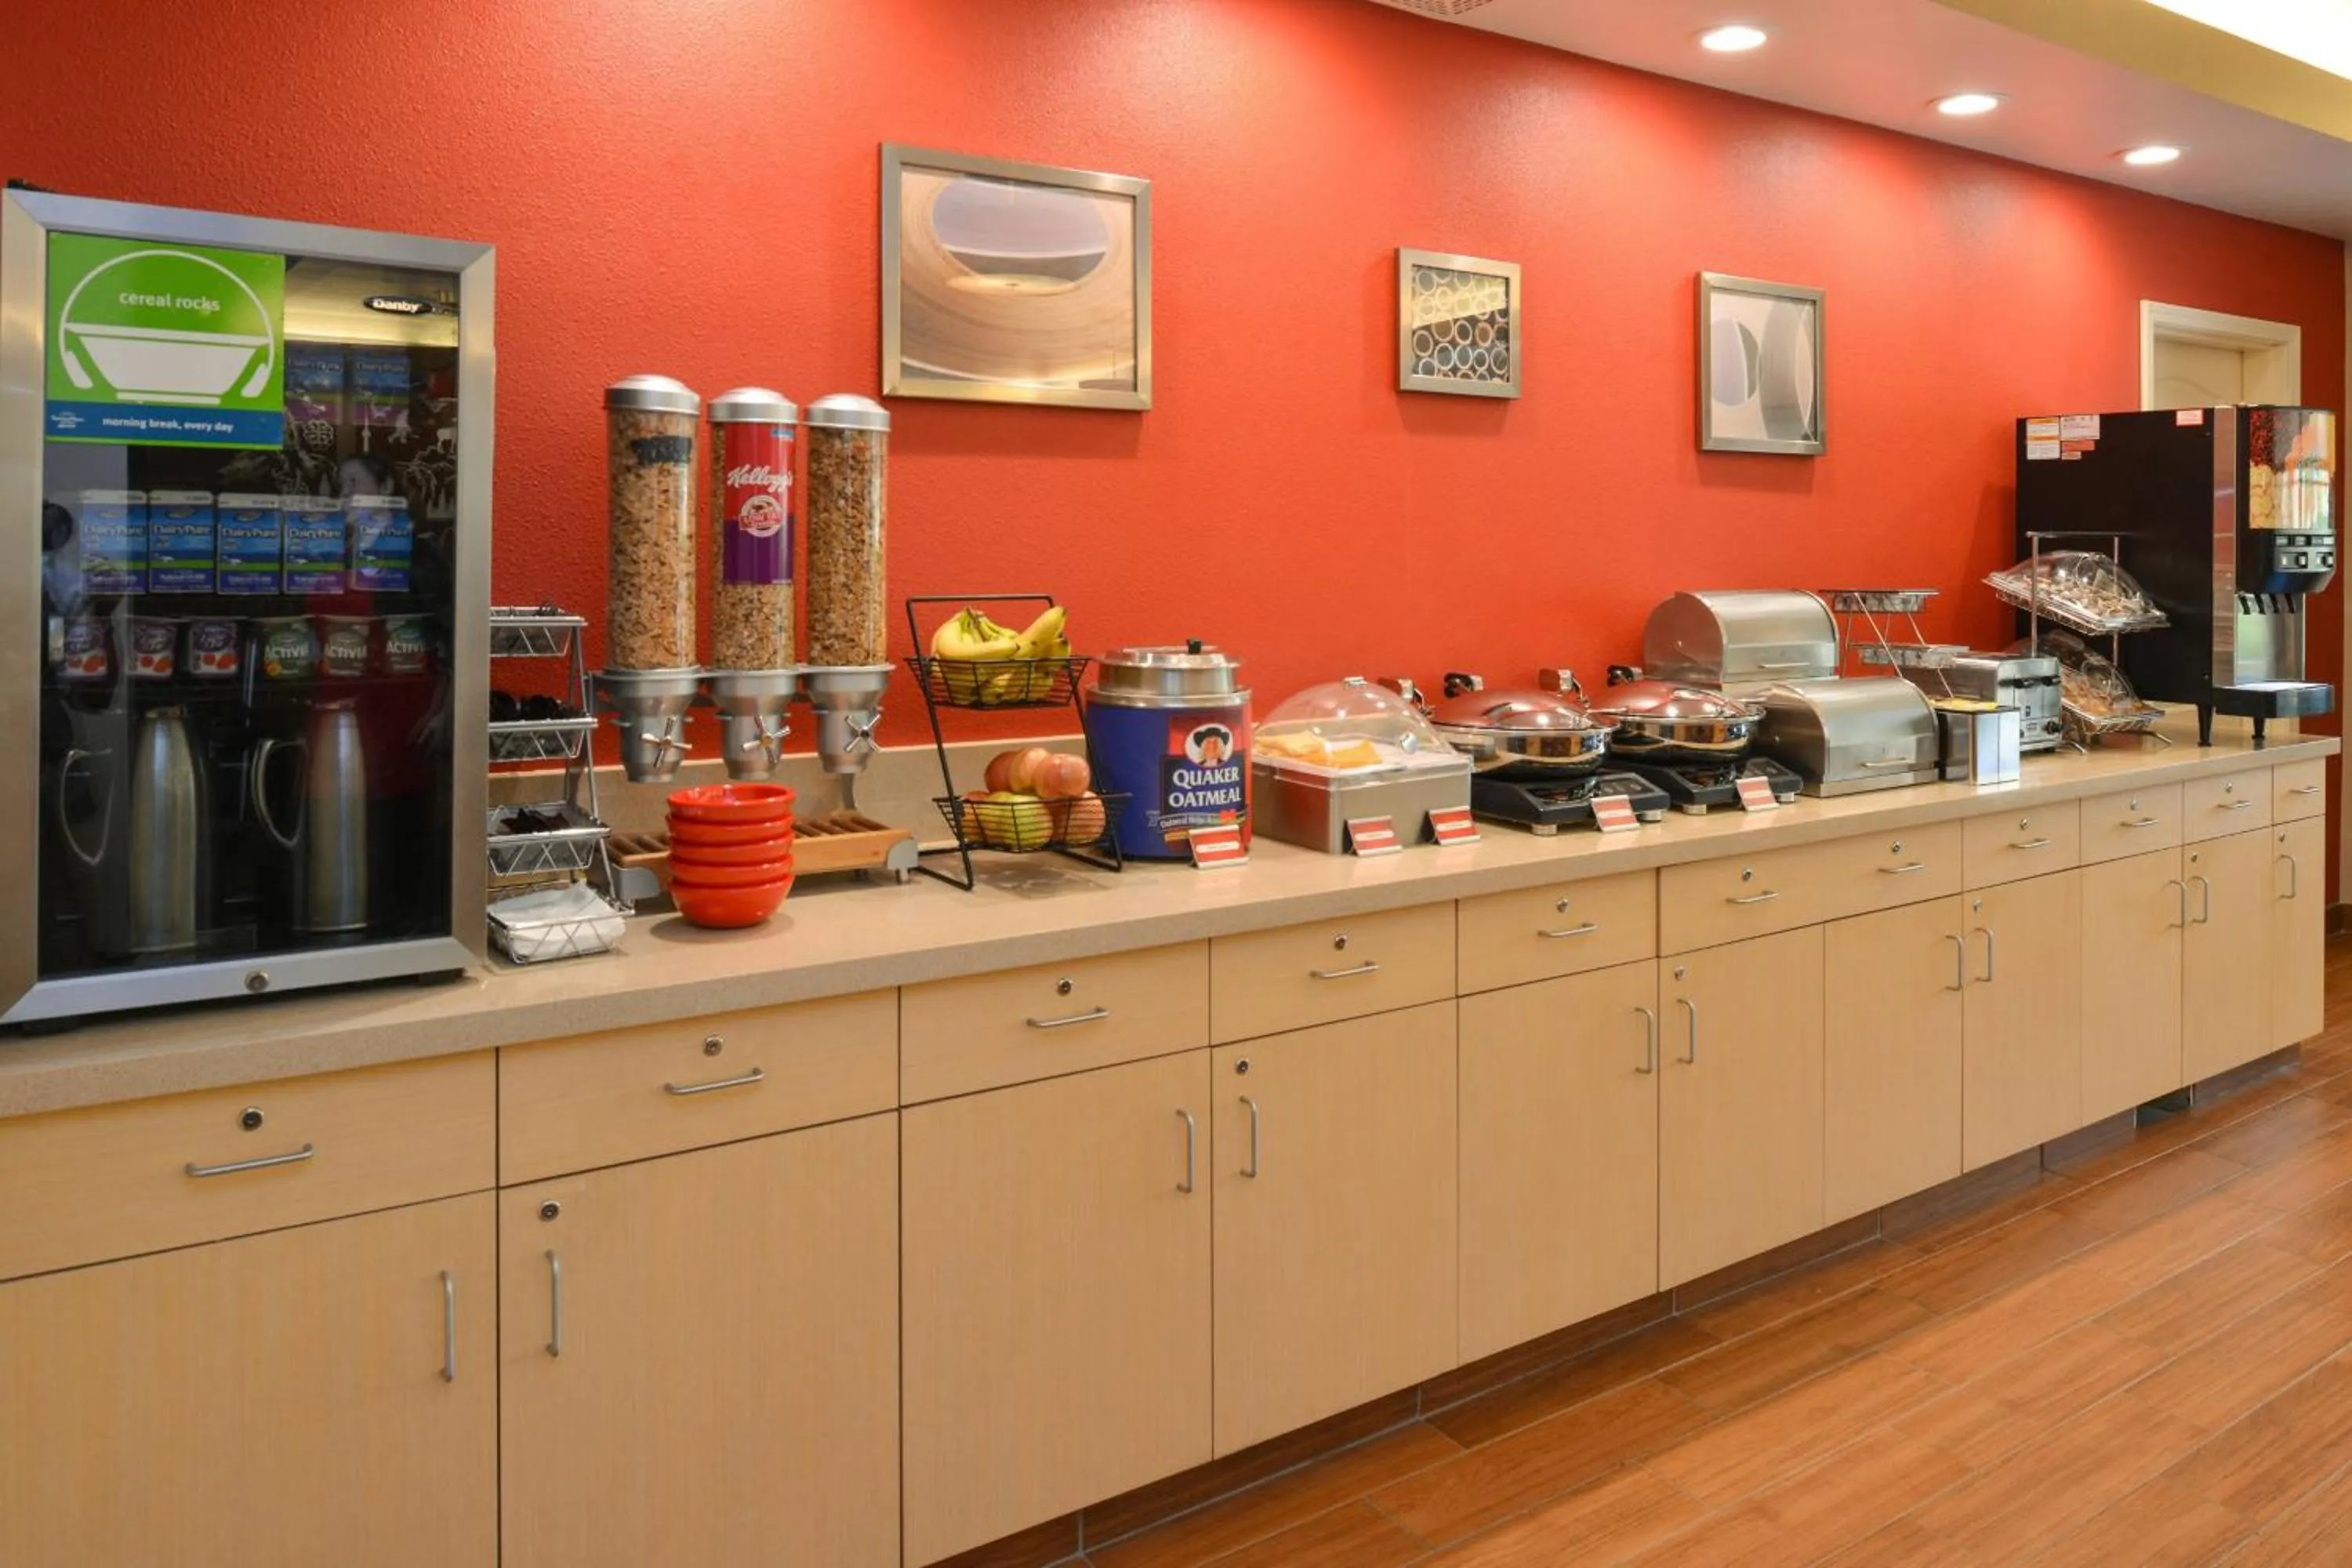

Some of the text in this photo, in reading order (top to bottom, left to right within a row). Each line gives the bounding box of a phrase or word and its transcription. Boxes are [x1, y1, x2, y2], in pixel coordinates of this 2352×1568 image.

[119, 292, 220, 311] cereal rocks
[372, 299, 422, 314] Danby
[103, 417, 234, 433] morning break, every day
[727, 464, 793, 492] Kellogg's
[1173, 767, 1240, 789] QUAKER
[1168, 786, 1242, 808] OATMEAL
